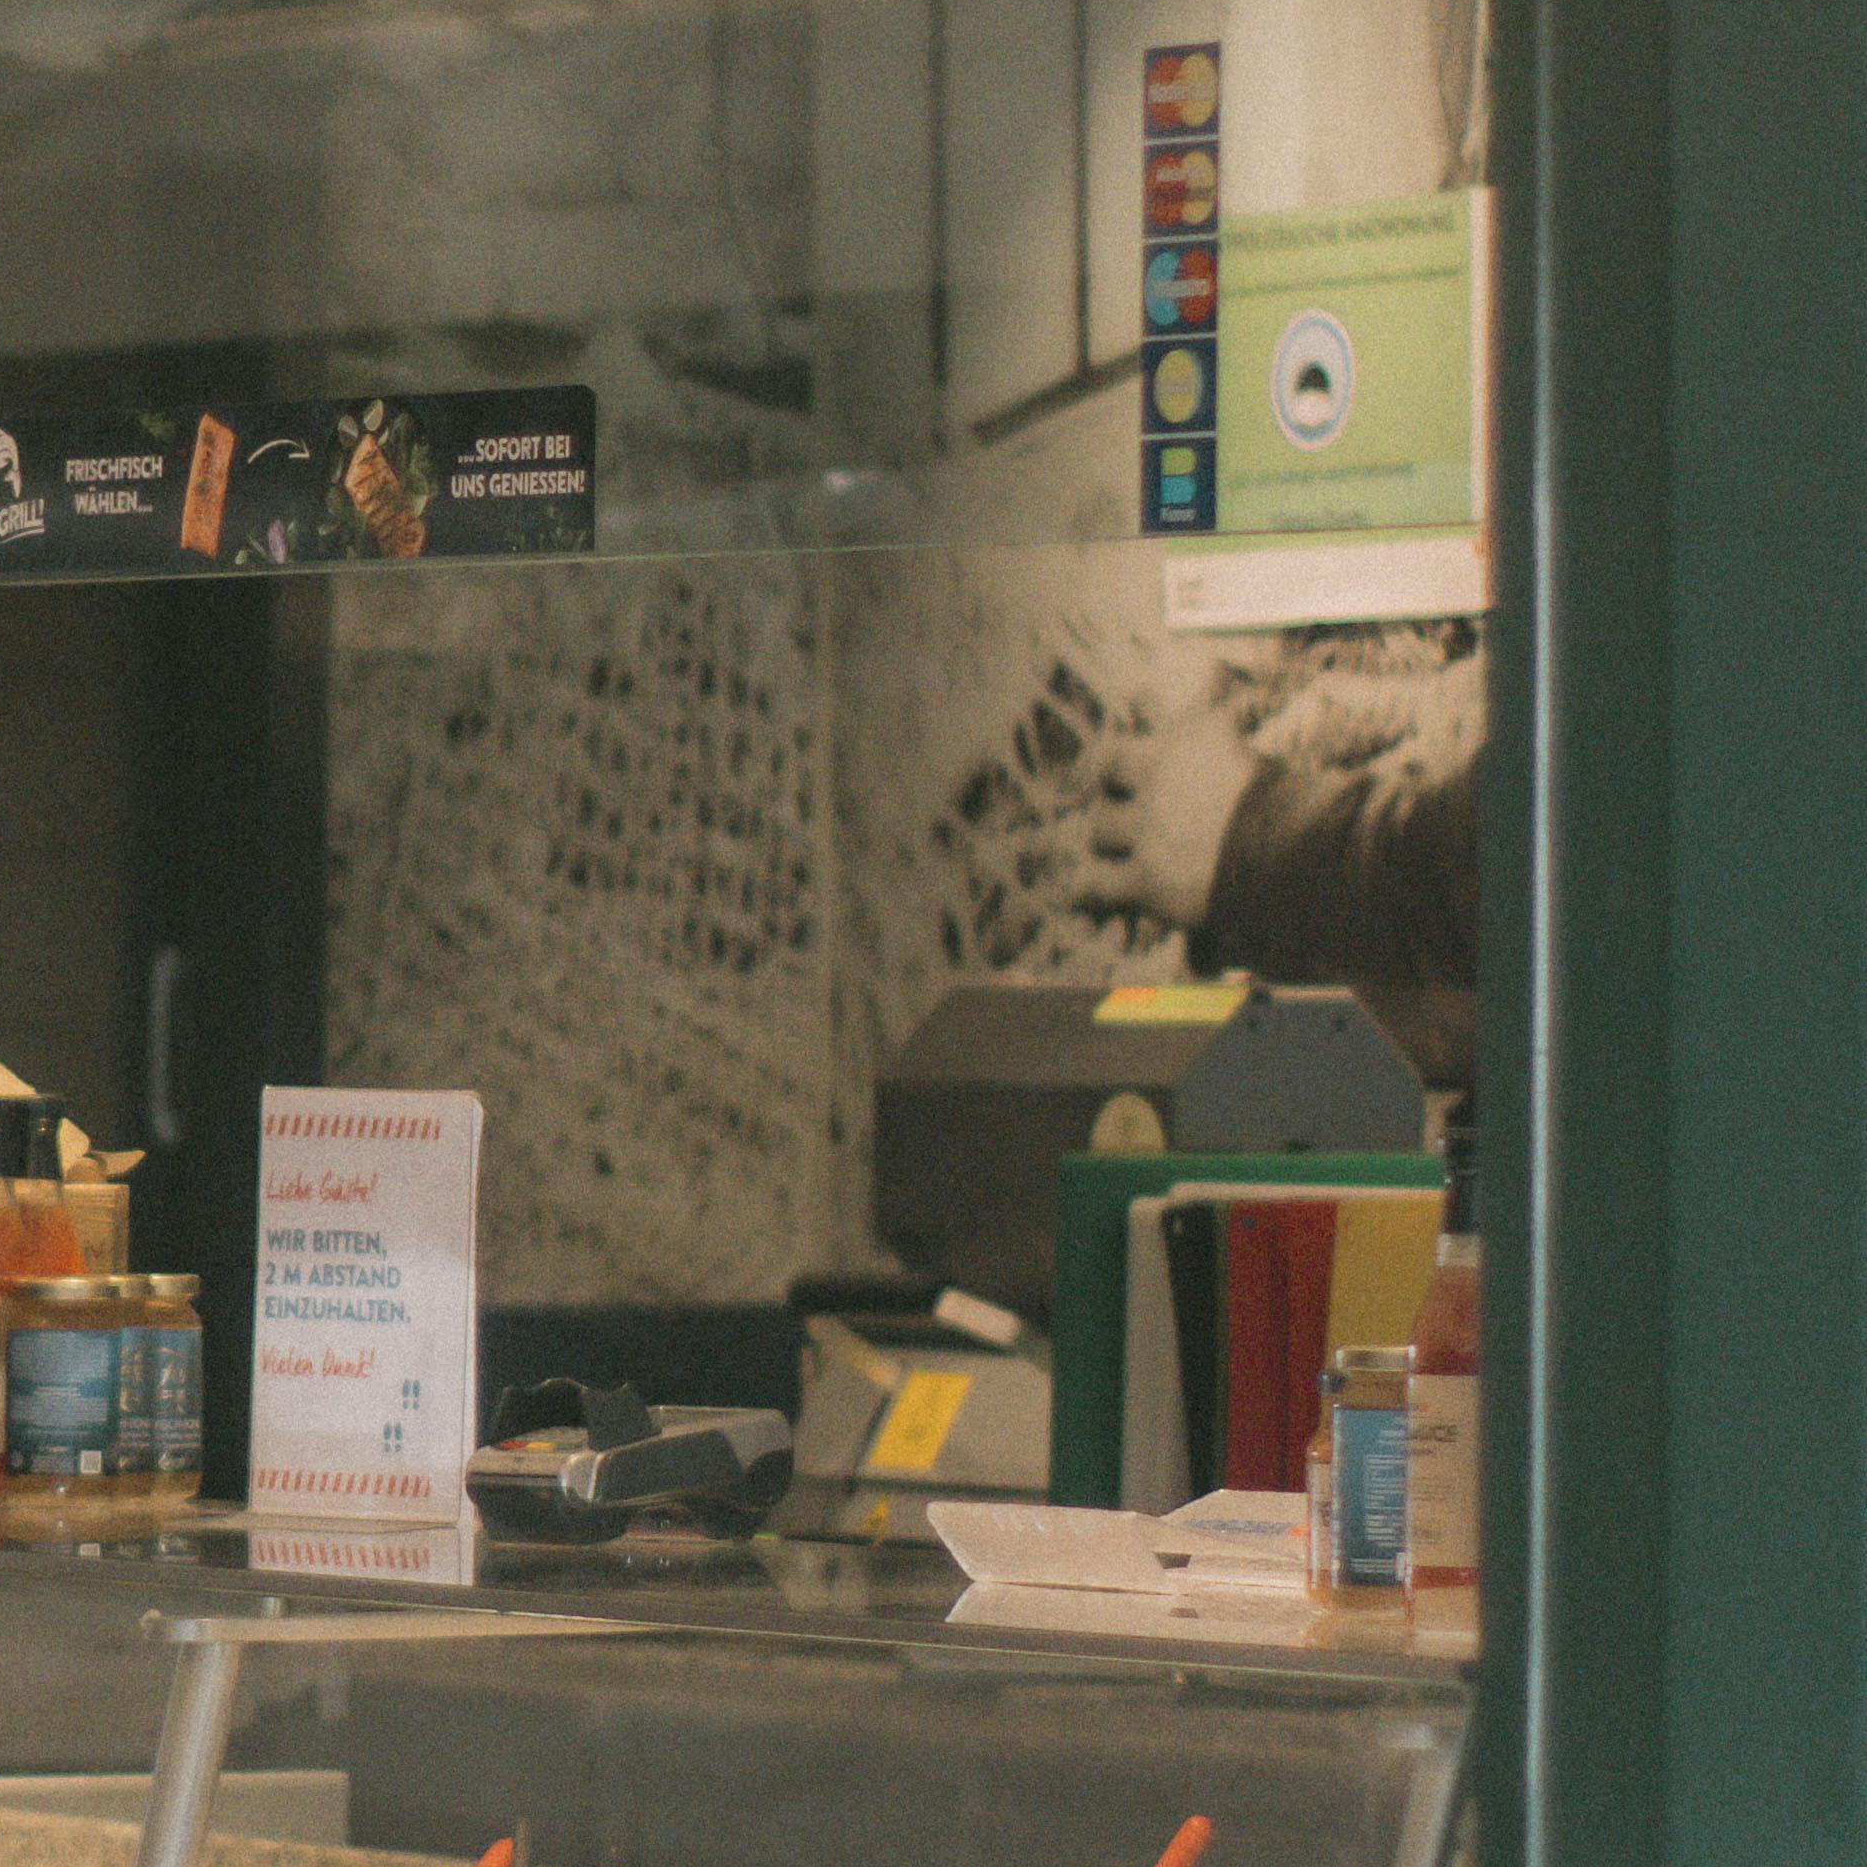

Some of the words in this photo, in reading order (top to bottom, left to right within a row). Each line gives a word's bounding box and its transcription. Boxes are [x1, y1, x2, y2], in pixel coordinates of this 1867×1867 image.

[544, 435, 570, 460] BEI
[65, 456, 163, 483] FRISCHFISCH
[452, 474, 486, 498] UNS
[489, 469, 584, 496] GENIESSEN!
[267, 1229, 306, 1252] WIR
[313, 1230, 387, 1257] BITTEN,
[264, 1262, 277, 1285] 2
[283, 1263, 301, 1282] M
[308, 1264, 402, 1289] ABSTAND
[265, 1296, 412, 1323] EINZUHALTEN.
